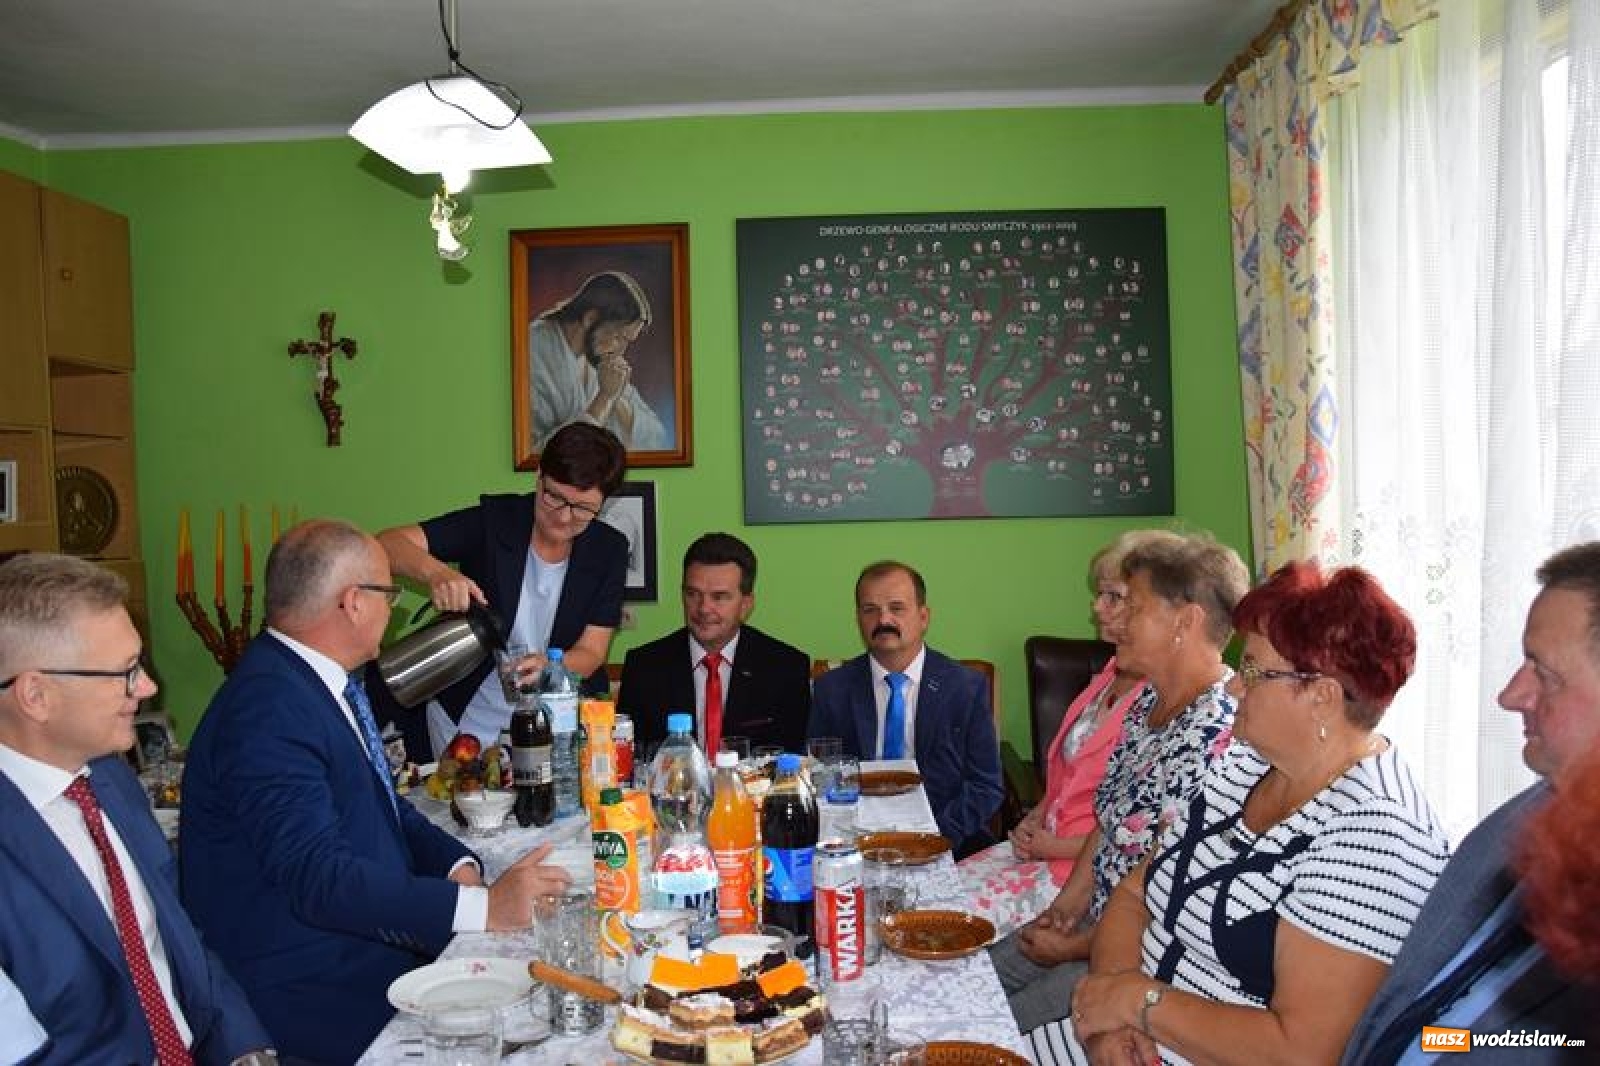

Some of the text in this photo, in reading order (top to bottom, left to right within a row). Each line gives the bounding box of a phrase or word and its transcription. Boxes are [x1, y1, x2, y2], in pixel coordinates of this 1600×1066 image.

[819, 225, 864, 237] DRZEWO
[866, 222, 948, 235] GENEALOGICZNE
[949, 221, 979, 232] RODU
[835, 880, 857, 981] WARKA
